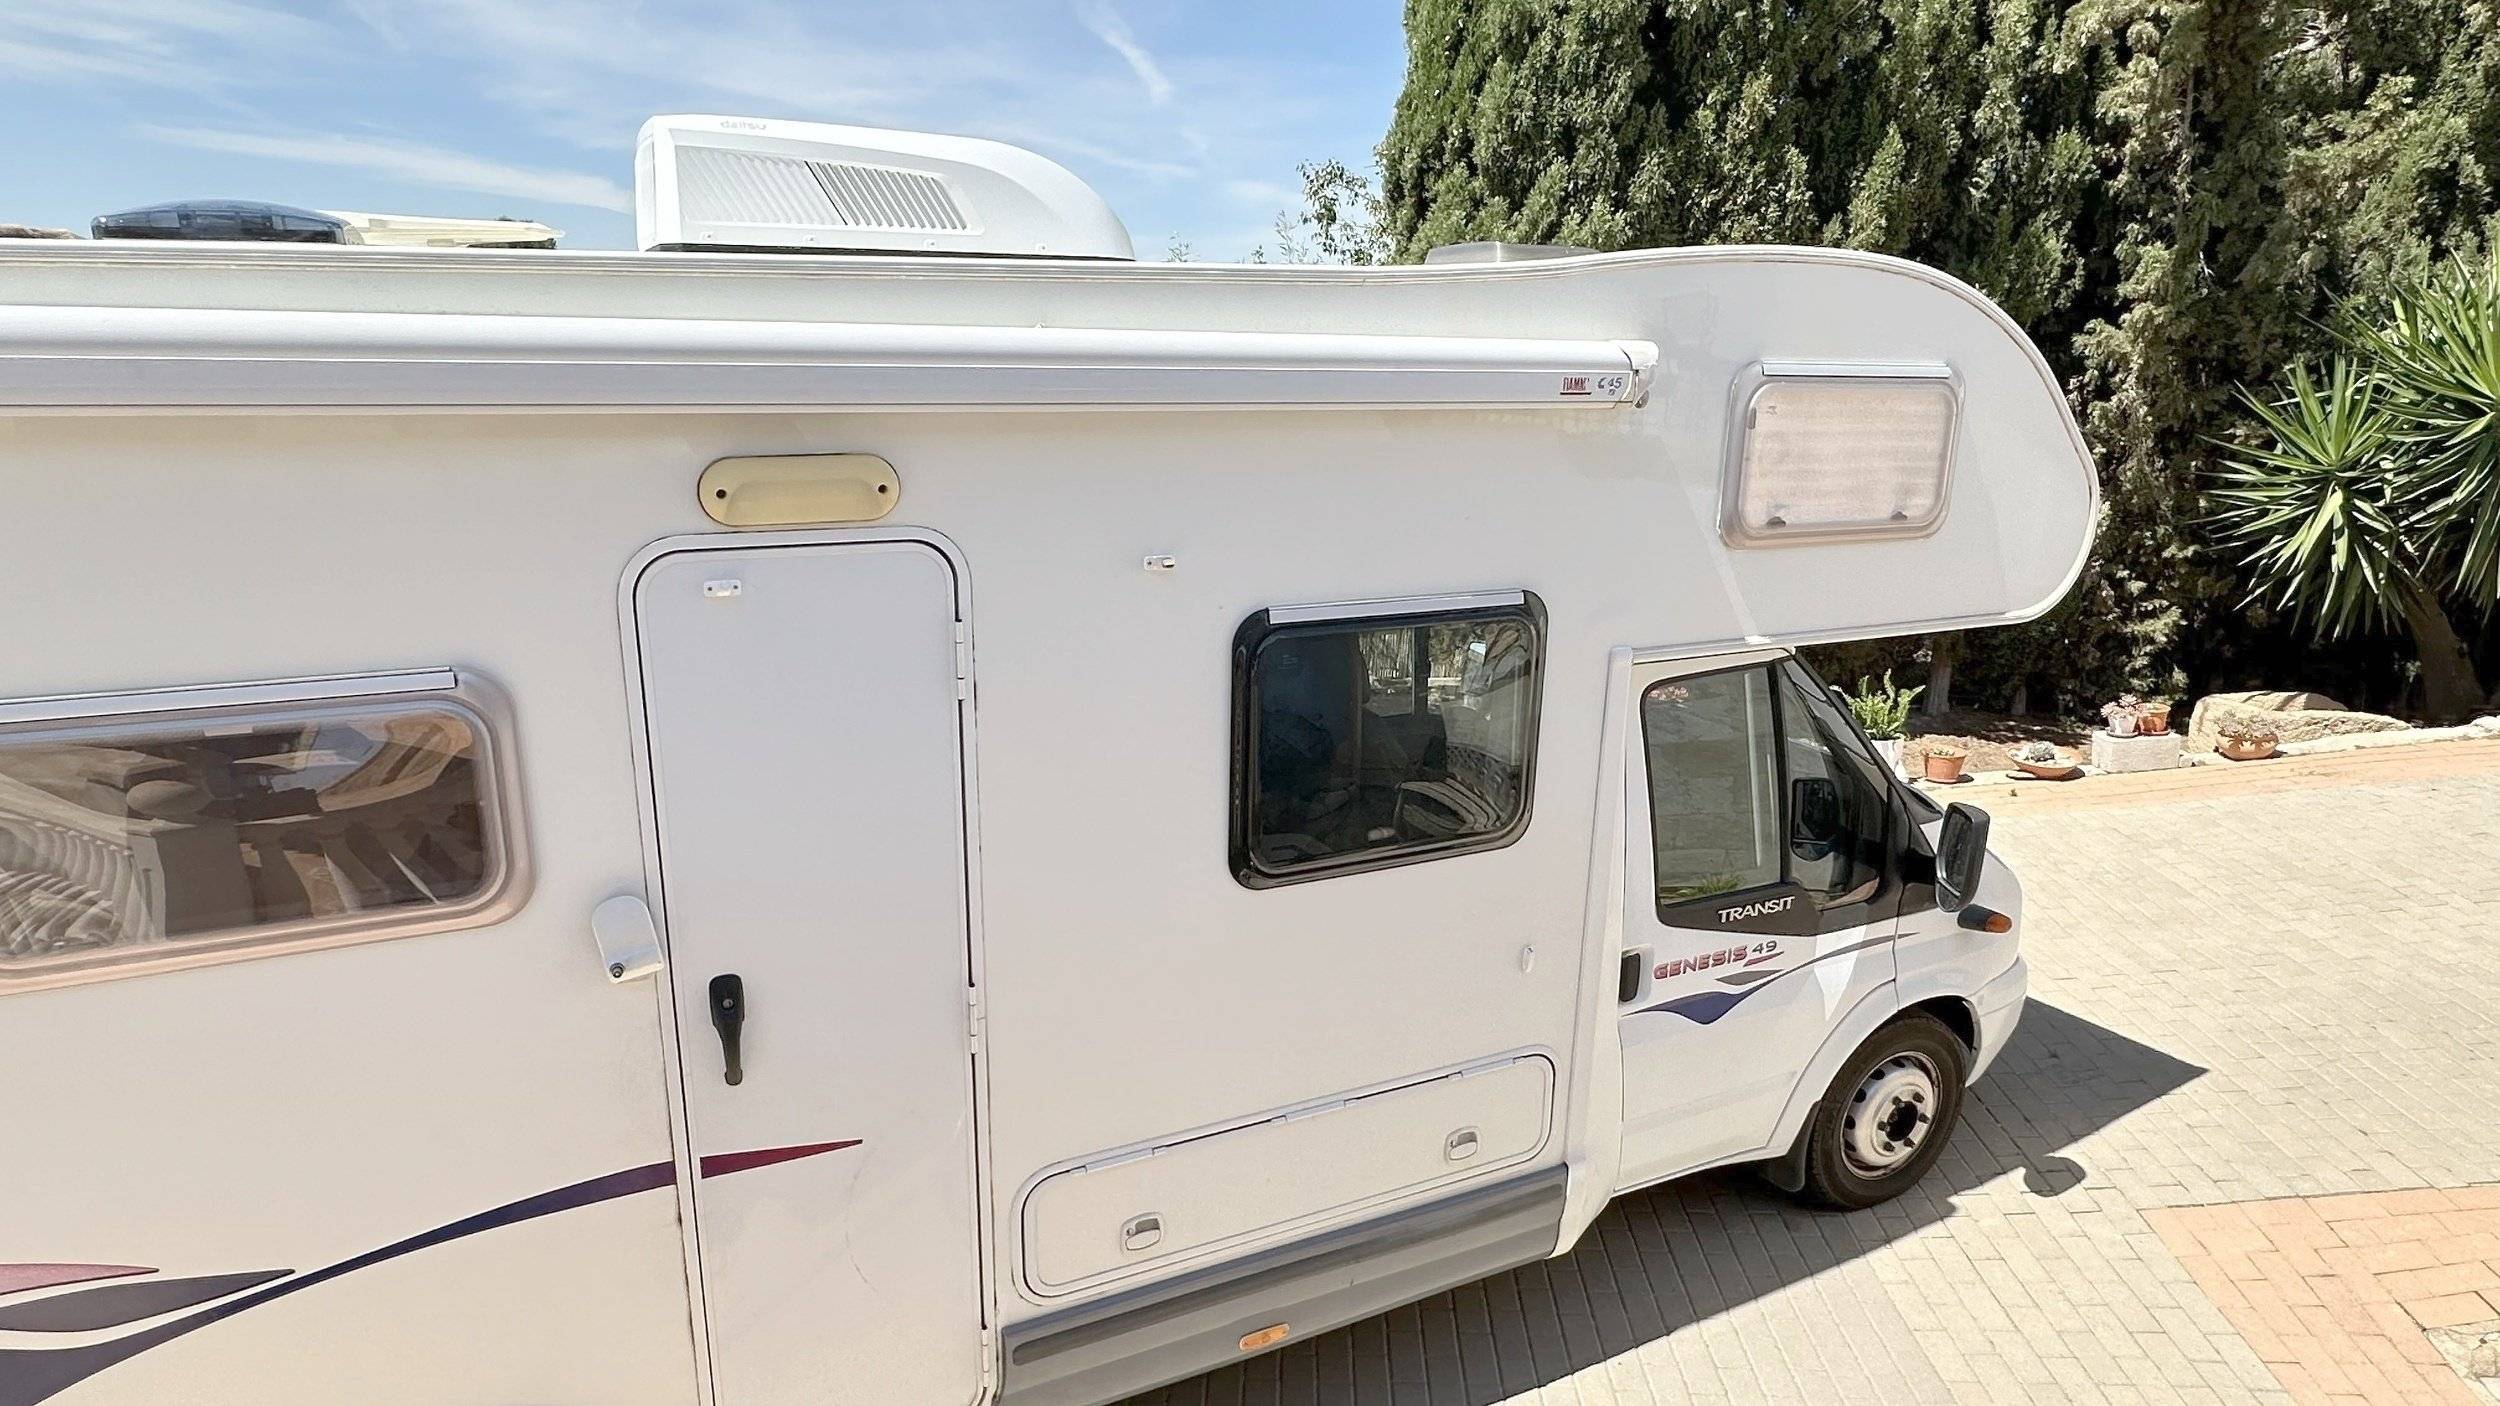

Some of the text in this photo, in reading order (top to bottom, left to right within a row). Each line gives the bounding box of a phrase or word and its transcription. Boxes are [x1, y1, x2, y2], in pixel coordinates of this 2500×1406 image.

[1718, 896, 1795, 924] TRANSIT
[1653, 940, 1777, 980] GENESIS 49
